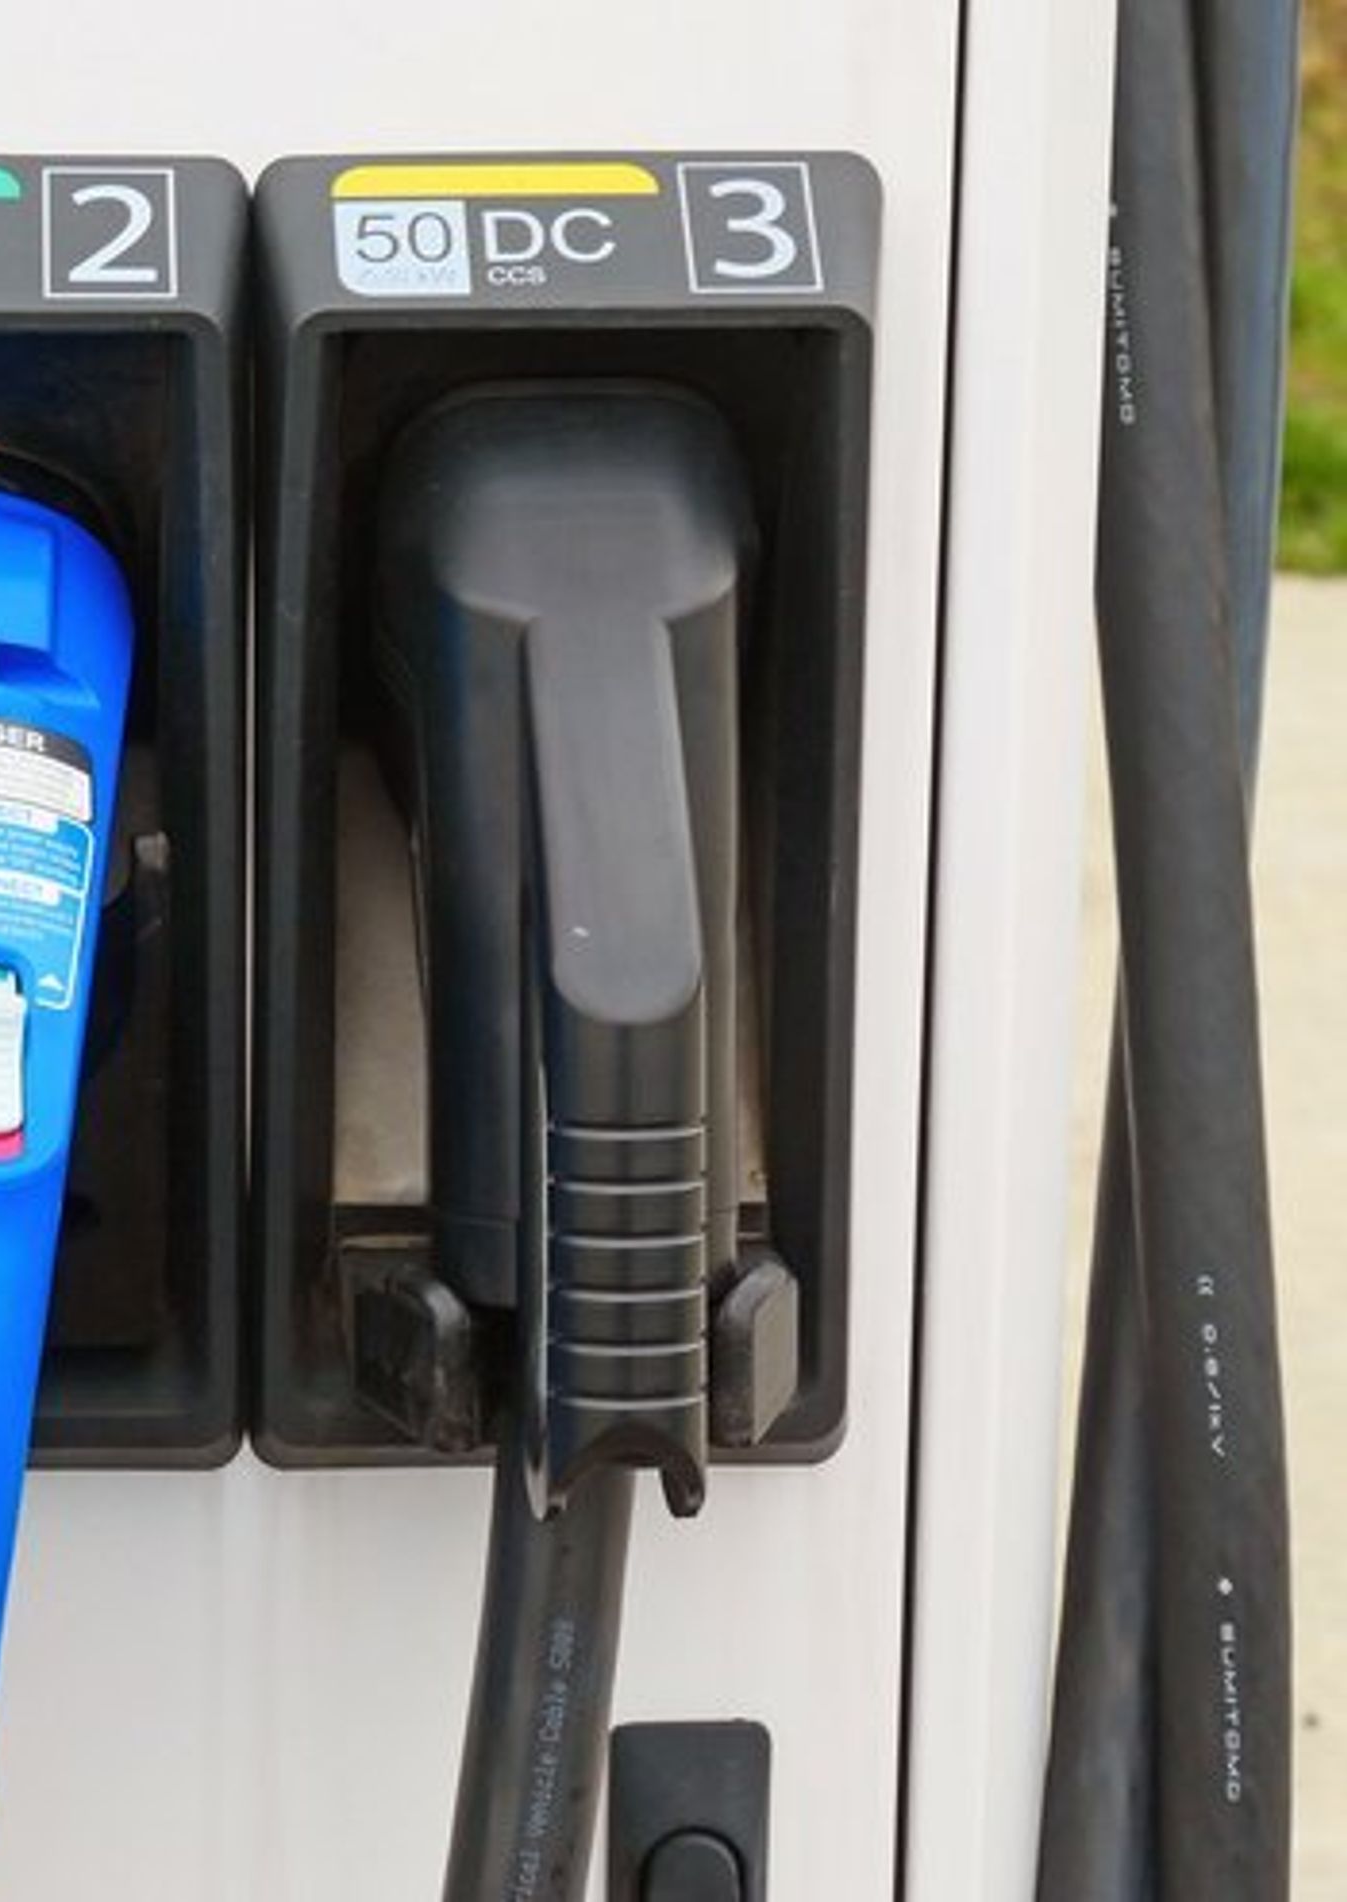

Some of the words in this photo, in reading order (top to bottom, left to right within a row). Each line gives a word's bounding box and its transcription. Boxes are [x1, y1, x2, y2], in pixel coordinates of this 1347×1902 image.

[68, 183, 159, 283] 2
[355, 211, 453, 263] 50
[481, 208, 617, 263] DC
[487, 266, 547, 286] CCS
[708, 178, 798, 279] 3
[1219, 1622, 1242, 1803] SUMITOMO
